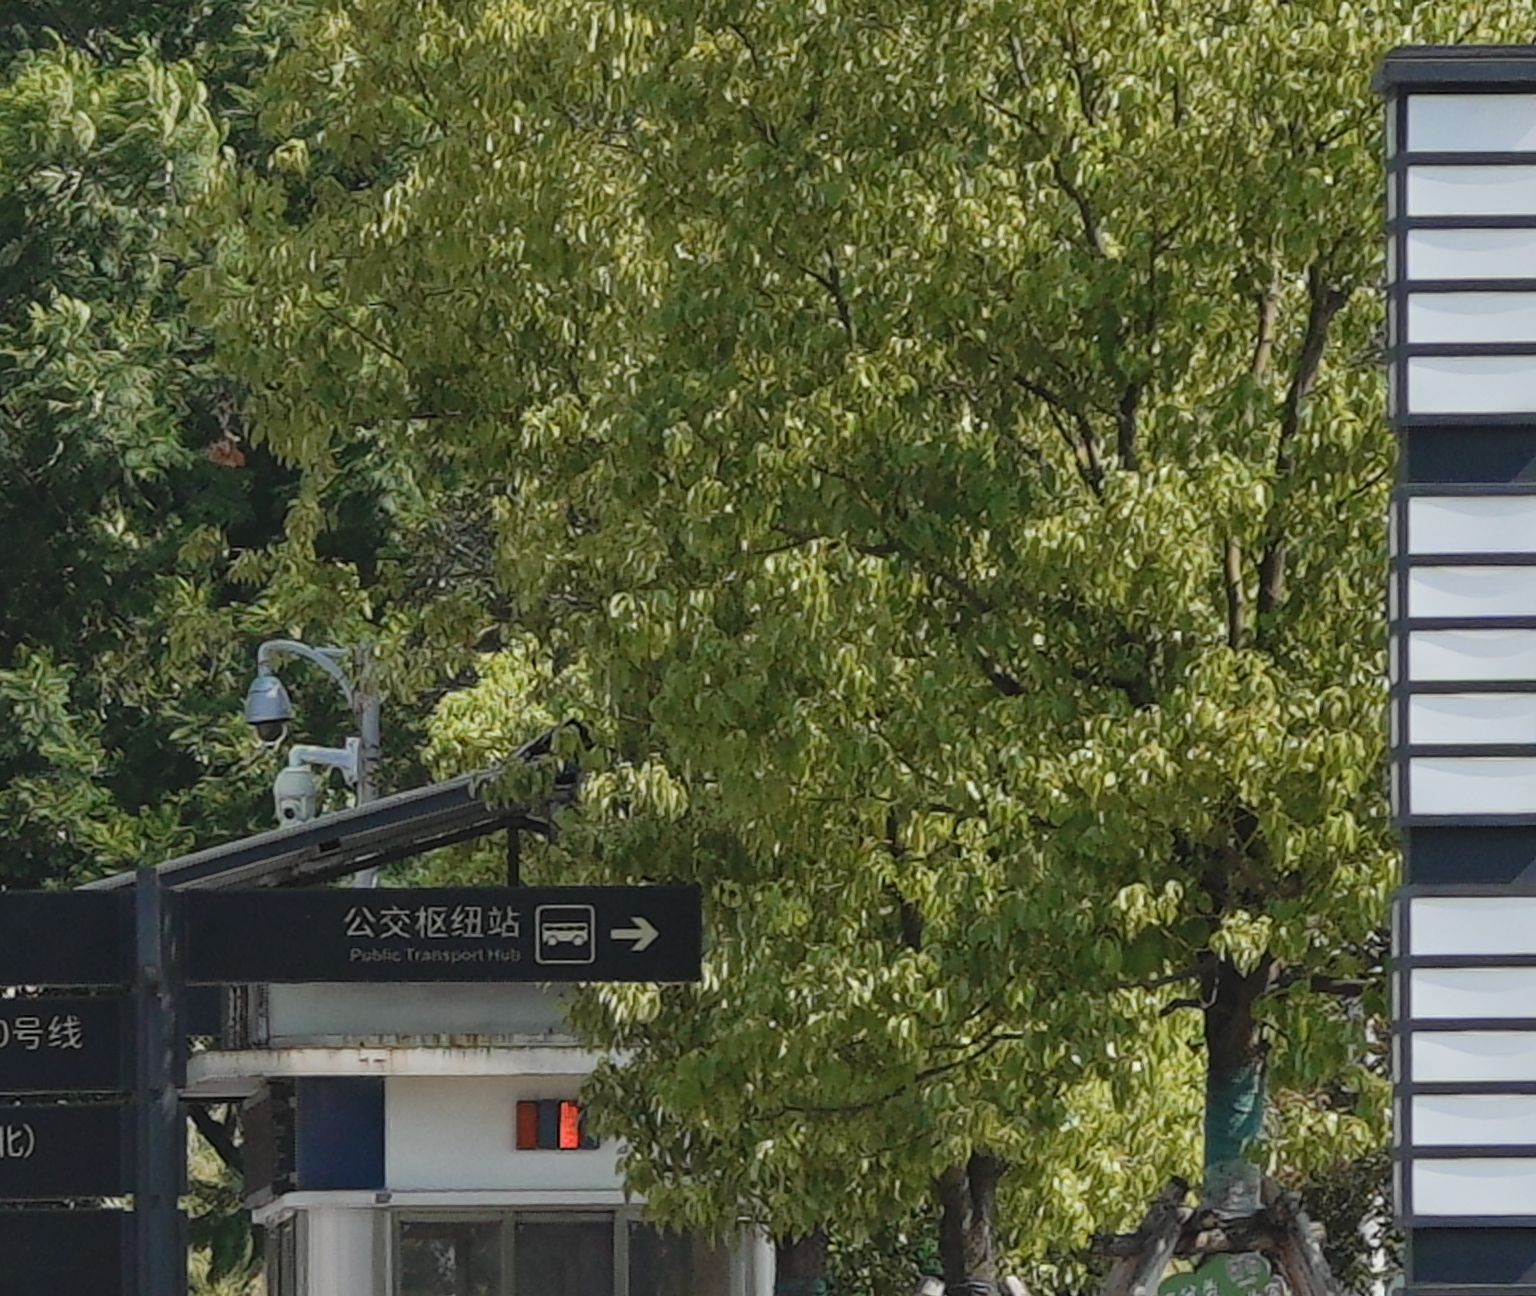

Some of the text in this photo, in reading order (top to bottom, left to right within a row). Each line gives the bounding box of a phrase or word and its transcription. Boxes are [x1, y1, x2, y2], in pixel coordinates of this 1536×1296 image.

[343, 904, 521, 939] 公交枢纽站
[350, 948, 521, 965] Public Transport Hub
